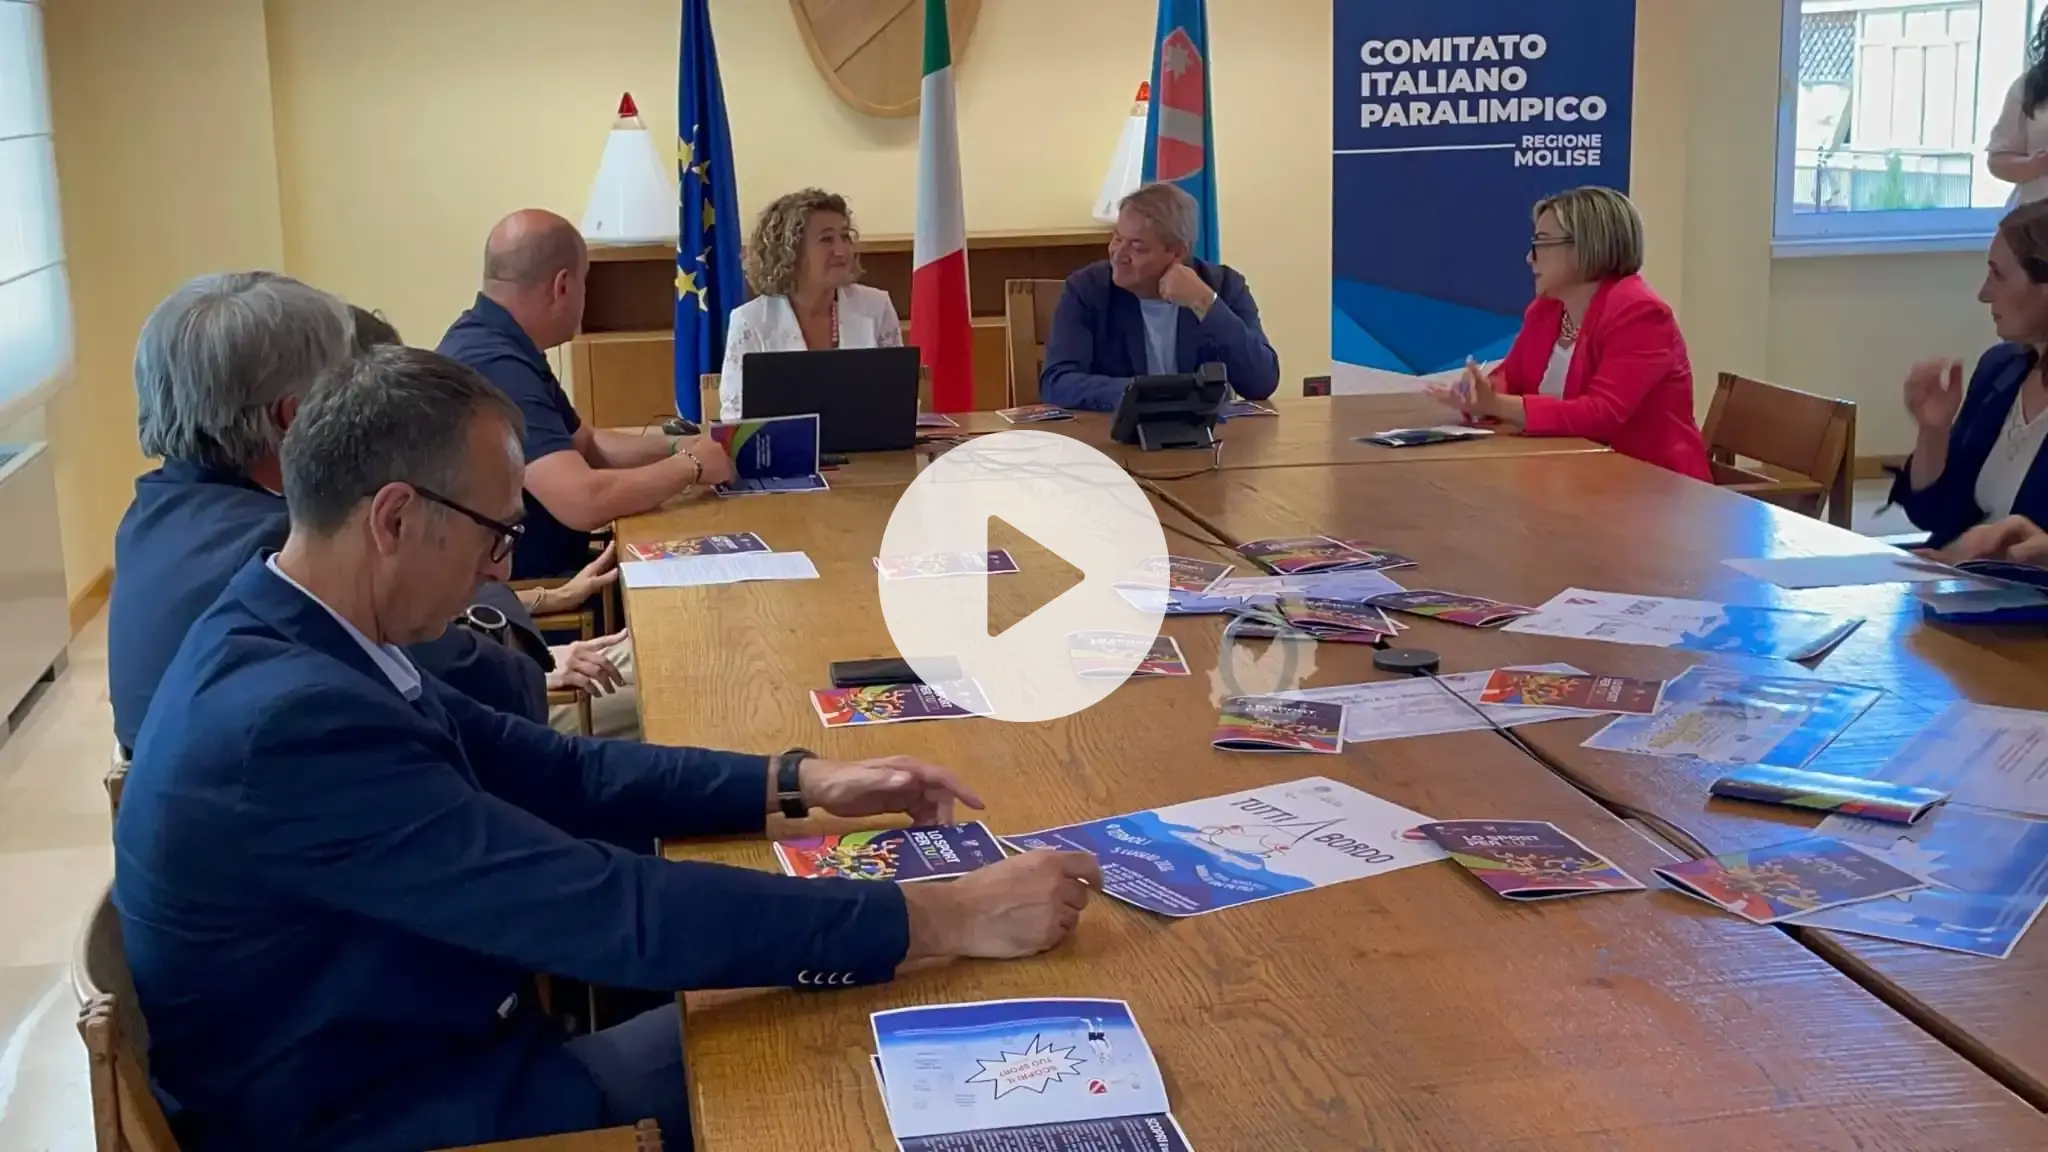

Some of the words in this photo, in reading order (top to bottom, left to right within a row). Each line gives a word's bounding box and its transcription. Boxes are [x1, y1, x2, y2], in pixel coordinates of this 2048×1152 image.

[1360, 34, 1547, 66] COMITATO
[1360, 66, 1527, 97] ITALIANO
[1360, 96, 1607, 128] PARALIMPICO
[1522, 134, 1602, 148] REGIONE
[1514, 150, 1601, 167] MOLISE
[911, 831, 930, 846] PER
[927, 830, 943, 840] LO
[1229, 797, 1299, 823] TUTTI
[1313, 832, 1396, 864] BORDO
[933, 839, 961, 863] SPORT
[999, 1063, 1031, 1077] SPORT
[1031, 1058, 1054, 1068] TUO
[1016, 1065, 1058, 1081] SCOPRI
[1144, 1117, 1169, 1143] SCOPRI
